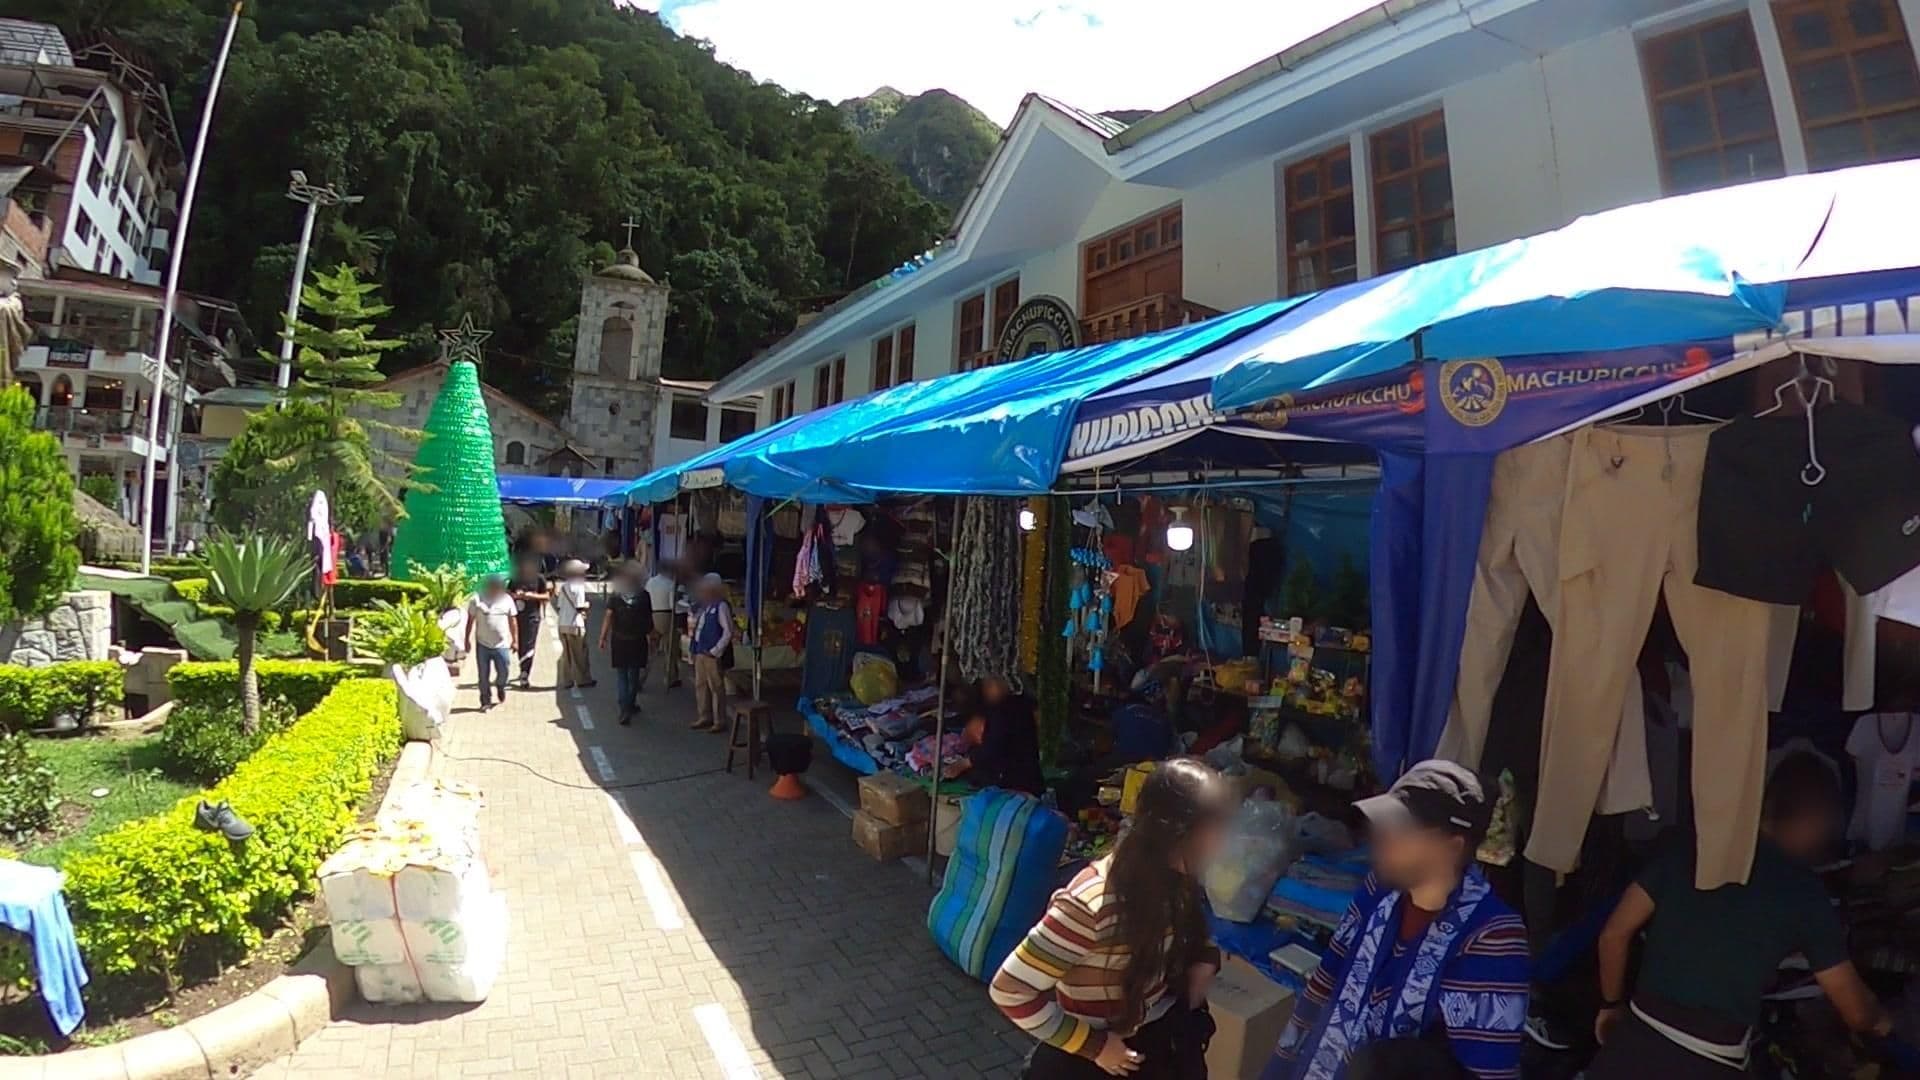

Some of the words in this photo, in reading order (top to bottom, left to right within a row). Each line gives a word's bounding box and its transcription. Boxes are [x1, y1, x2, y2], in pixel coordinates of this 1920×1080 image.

[1003, 304, 1073, 355] MACHUPICCHU
[1506, 361, 1688, 393] MACHUPICC
[1290, 383, 1411, 413] ACHUPICCHU
